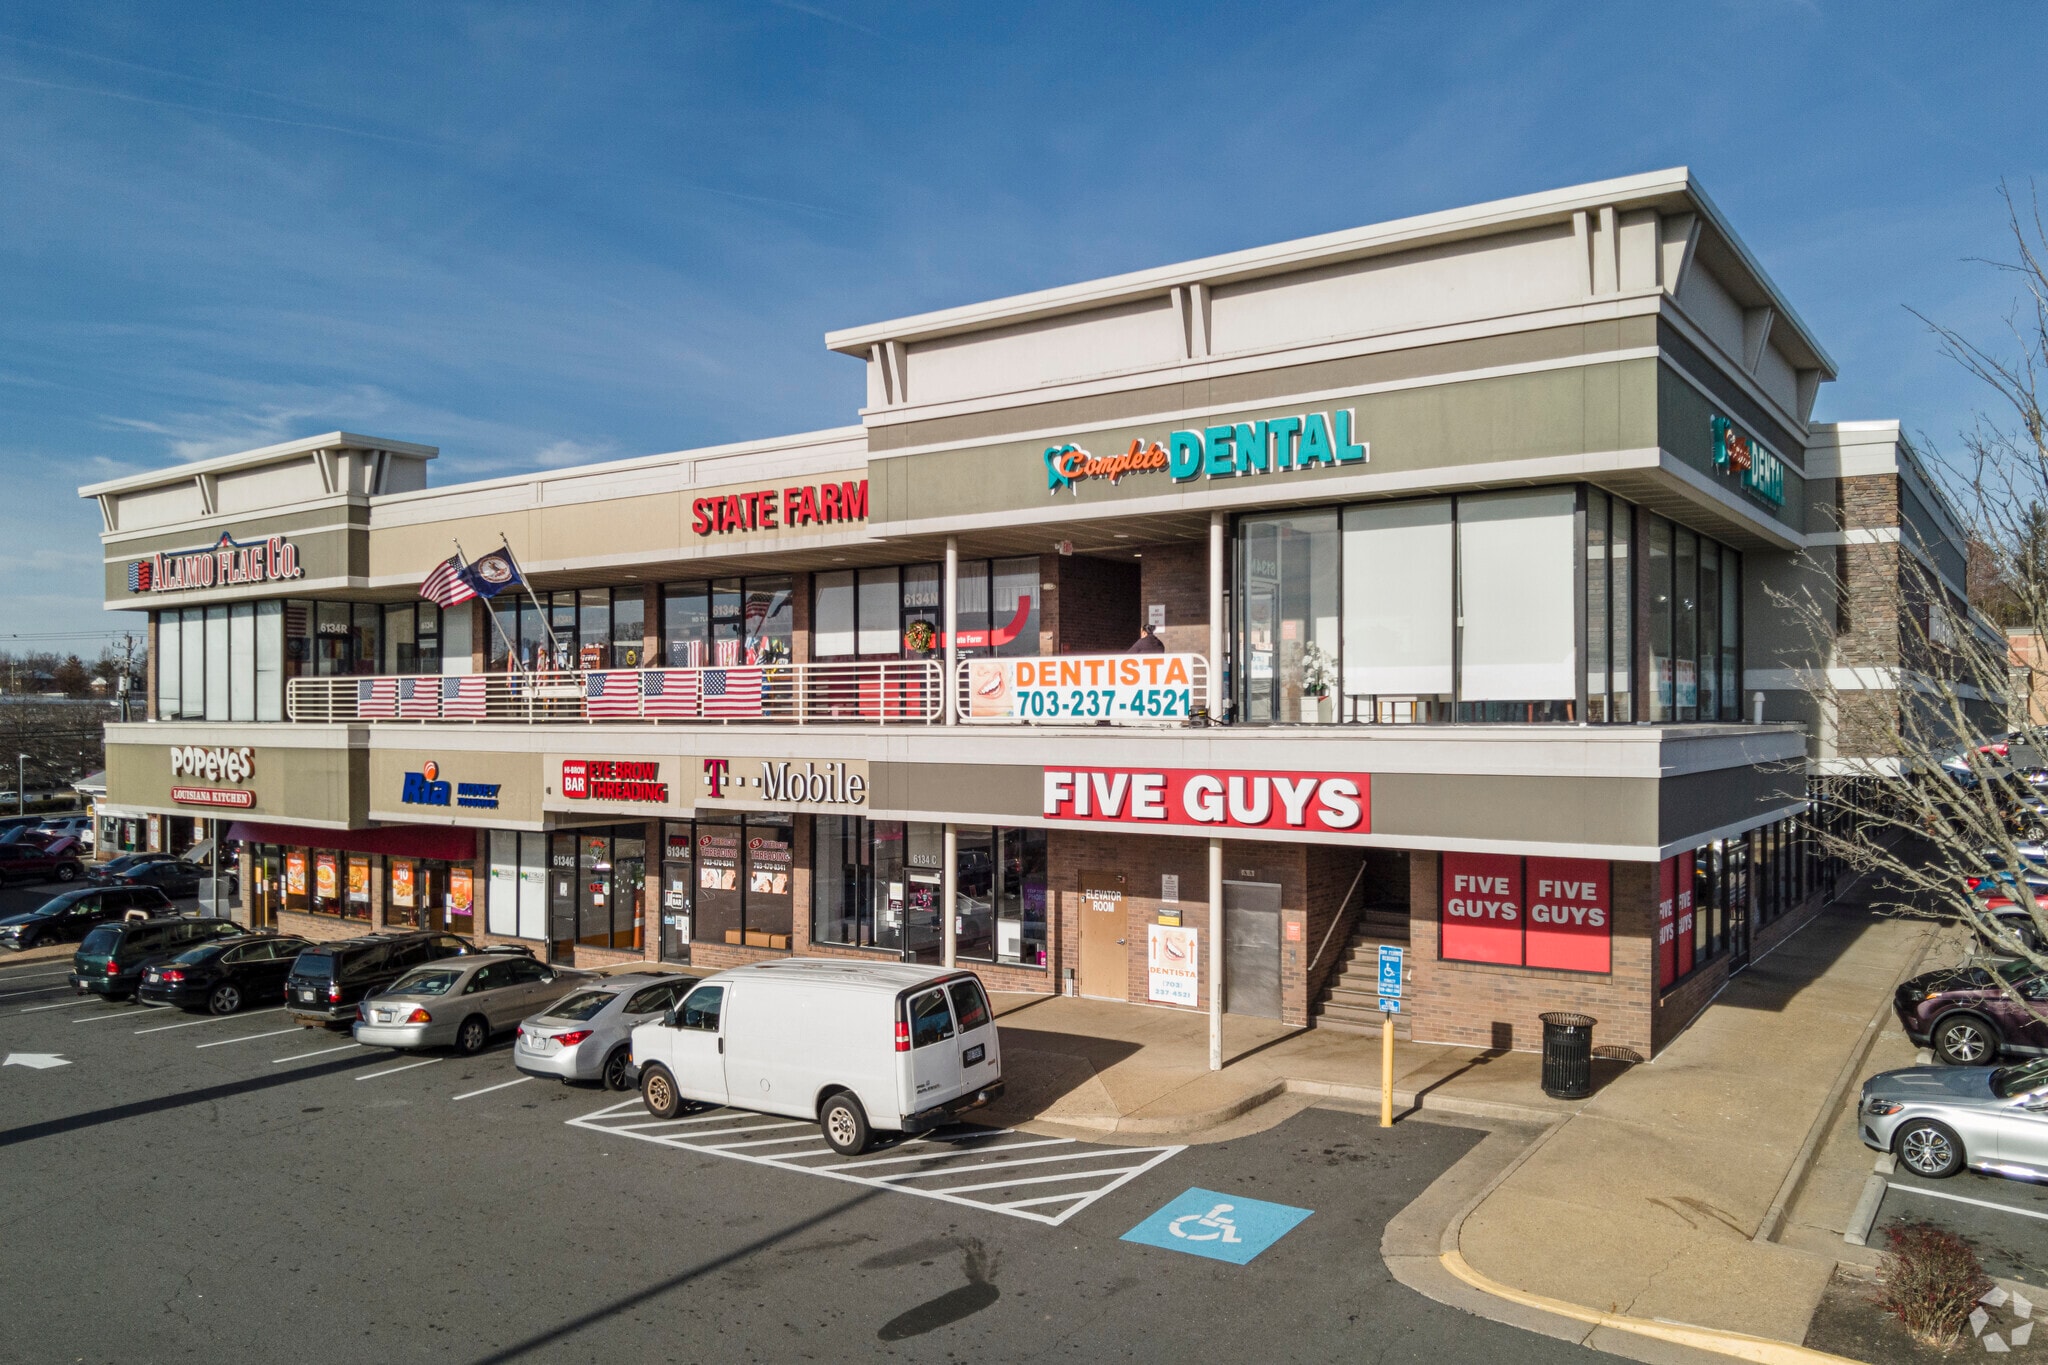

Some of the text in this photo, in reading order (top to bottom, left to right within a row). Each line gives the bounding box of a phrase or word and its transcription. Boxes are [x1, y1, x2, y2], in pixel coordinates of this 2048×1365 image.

[1059, 409, 1367, 481] Complete DENTAL
[692, 479, 868, 534] STATE FARM
[151, 552, 214, 591] ALAMO
[217, 547, 263, 585] FLAG
[904, 592, 938, 606] 6134N
[1016, 658, 1189, 687] DENTISTA
[1017, 688, 1190, 717] 703-237-4521
[589, 761, 657, 780] EYE-BROW
[402, 761, 452, 806] Ria
[565, 777, 584, 791] BAR
[590, 781, 667, 802] THREADING
[173, 789, 248, 803] LOUISIANA KITCHEN
[1044, 771, 1362, 829] FIVE GUYS
[666, 845, 689, 857] 6134E
[700, 847, 737, 858] THREADING
[751, 850, 790, 862] THREADING
[913, 855, 937, 865] 6134 C
[1085, 888, 1122, 902] ELEVATOR
[1454, 874, 1510, 896] FIVE
[1538, 879, 1598, 901] FIVE
[1092, 900, 1115, 912] ROOM
[1447, 898, 1518, 921] GUYS
[1531, 904, 1606, 927] GUYS
[1149, 966, 1196, 978] DENTISTA
